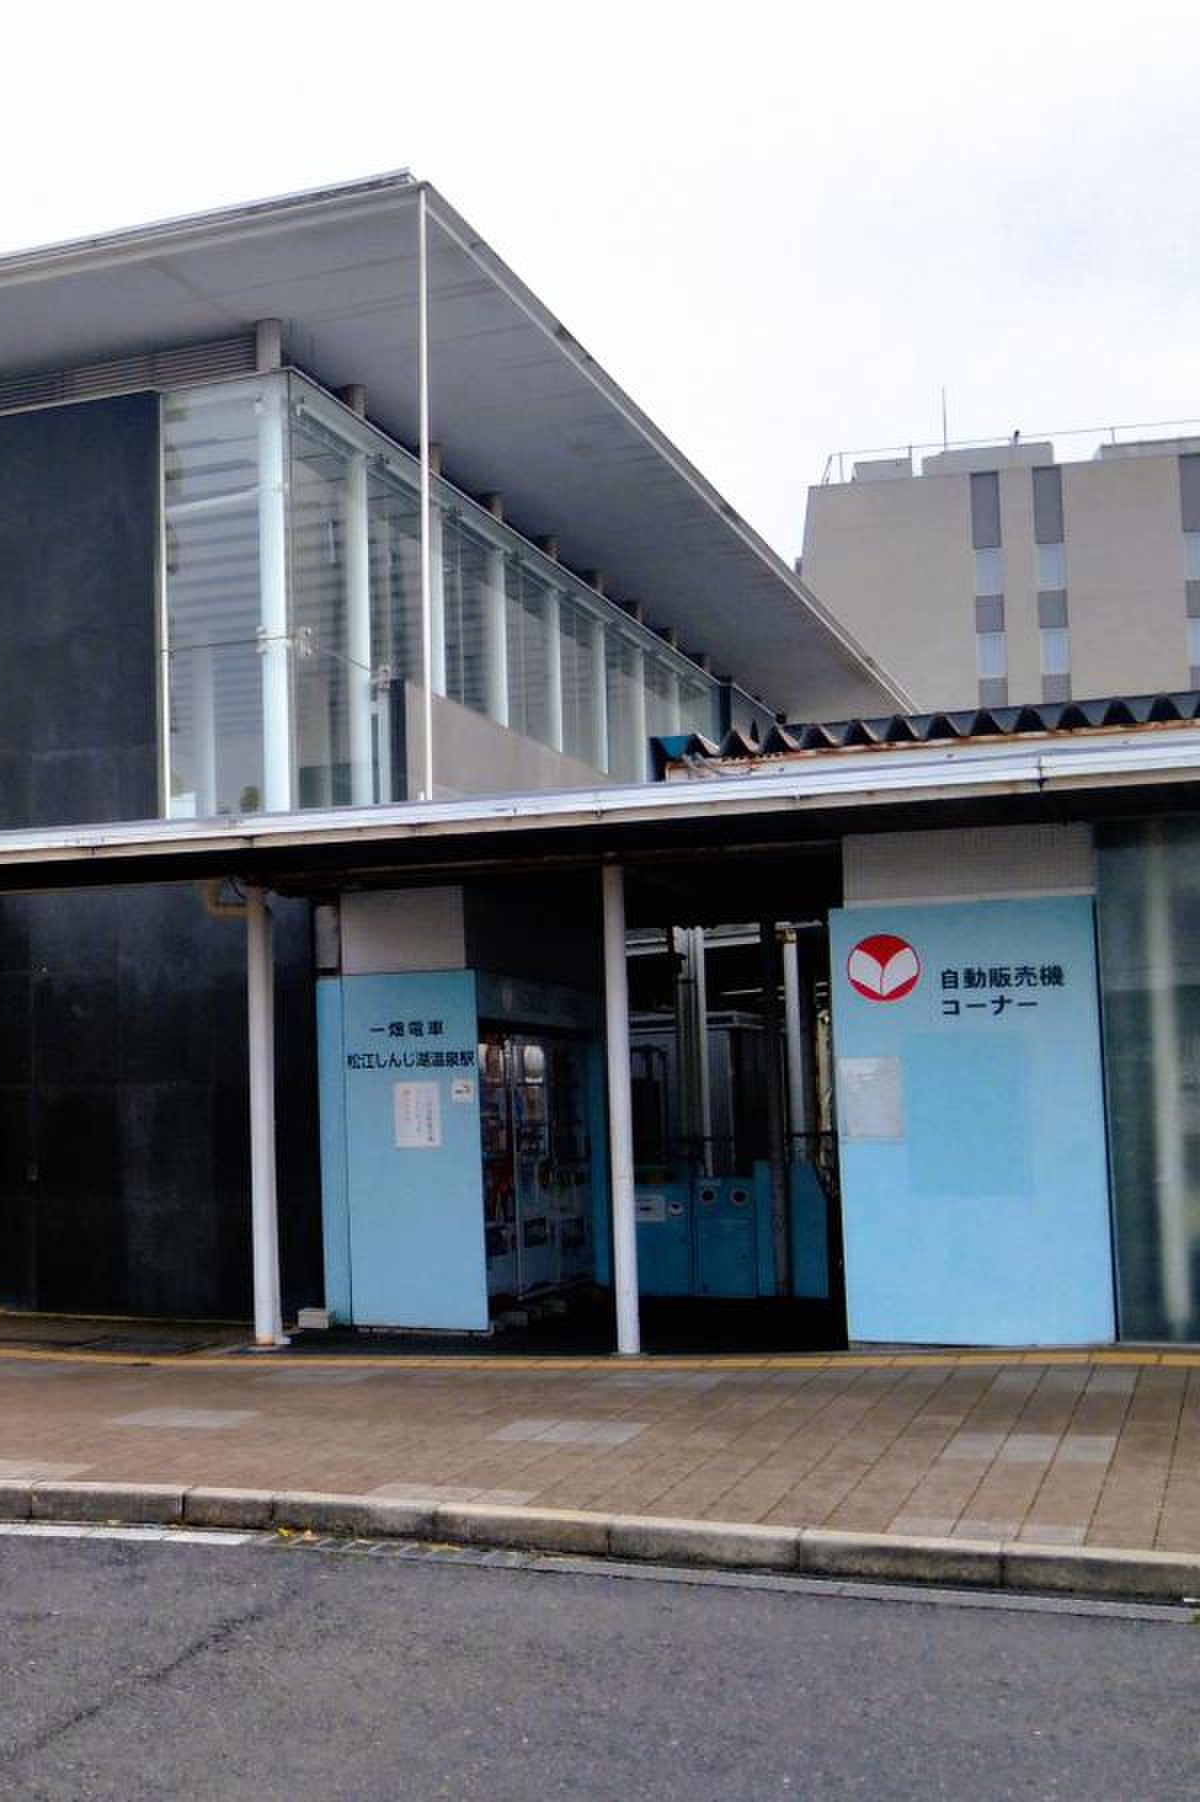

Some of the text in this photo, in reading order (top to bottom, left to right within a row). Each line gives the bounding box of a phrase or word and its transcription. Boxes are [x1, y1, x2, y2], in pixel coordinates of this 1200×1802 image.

[940, 965, 1065, 990] 自動販売機
[942, 996, 1039, 1016] コーナー
[369, 1020, 444, 1038] 一畑電車
[347, 1050, 476, 1070] 松江しんじ湖温泉駅
